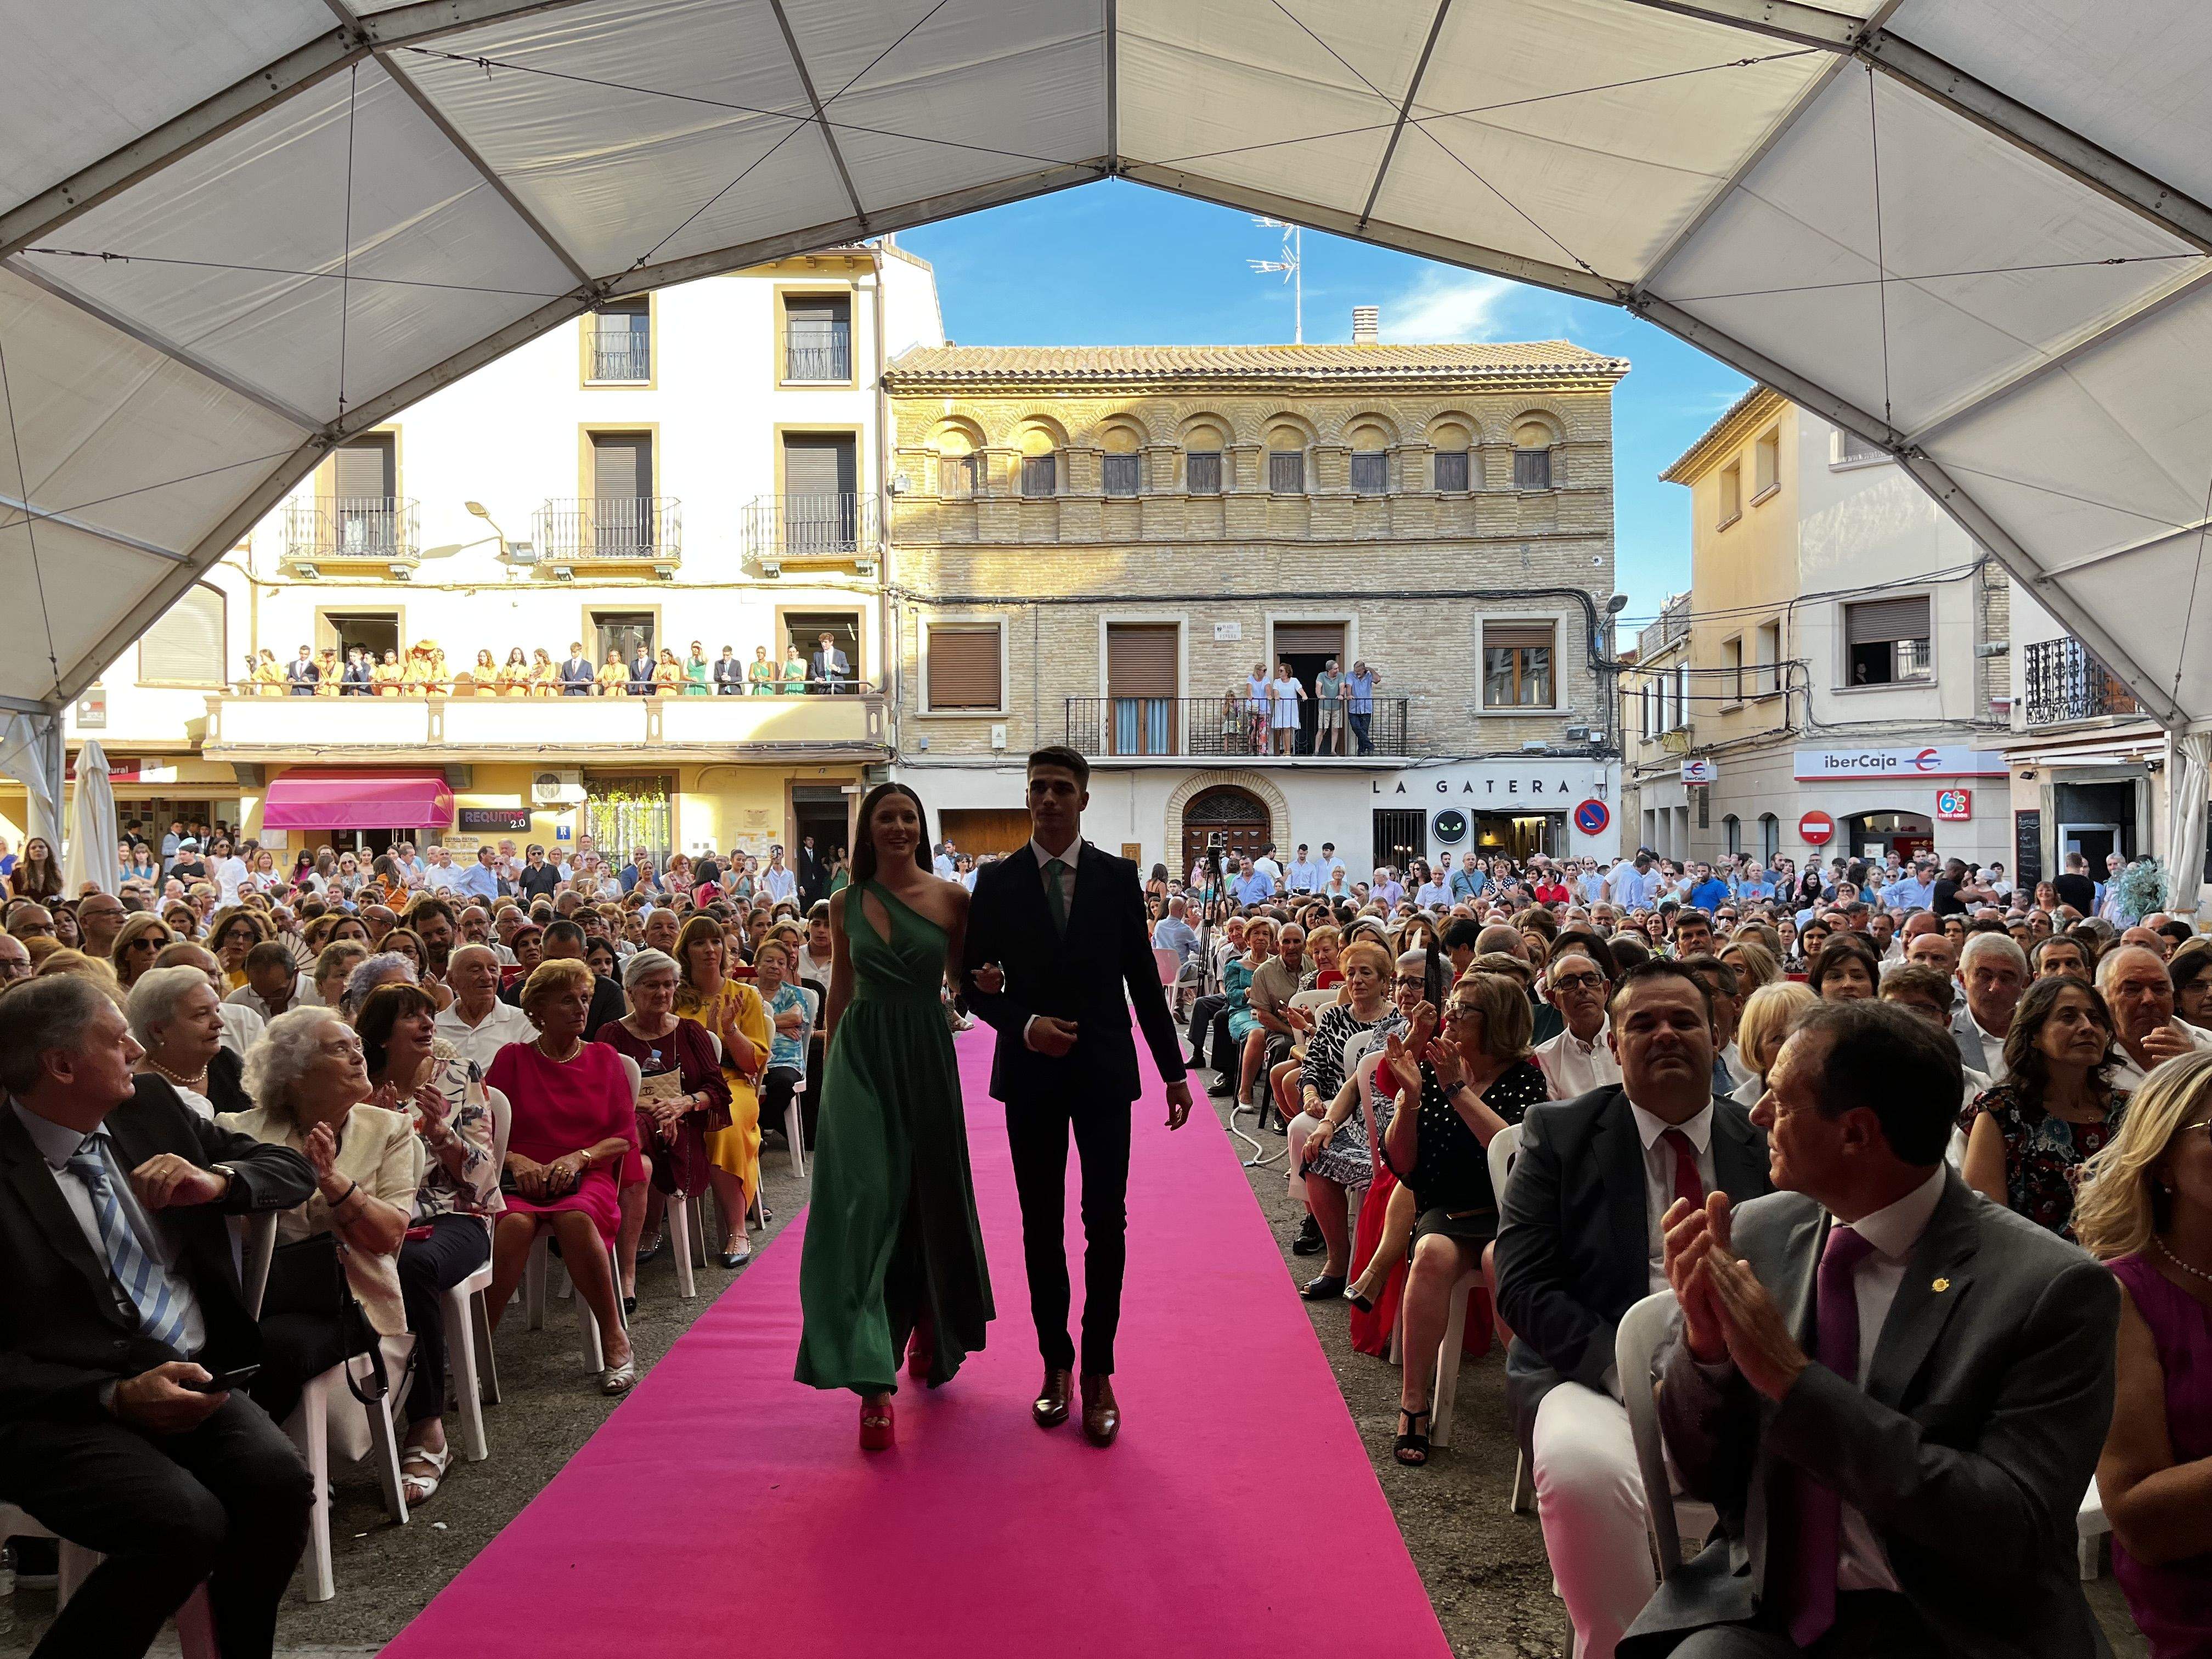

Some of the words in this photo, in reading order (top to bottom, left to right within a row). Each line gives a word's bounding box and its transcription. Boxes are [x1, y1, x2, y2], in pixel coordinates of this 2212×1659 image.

[1825, 754, 1897, 770] iberCaja
[1373, 780, 1406, 793] LA
[1436, 780, 1569, 793] GATERA
[510, 819, 526, 828] 2.0
[560, 826, 567, 836] R
